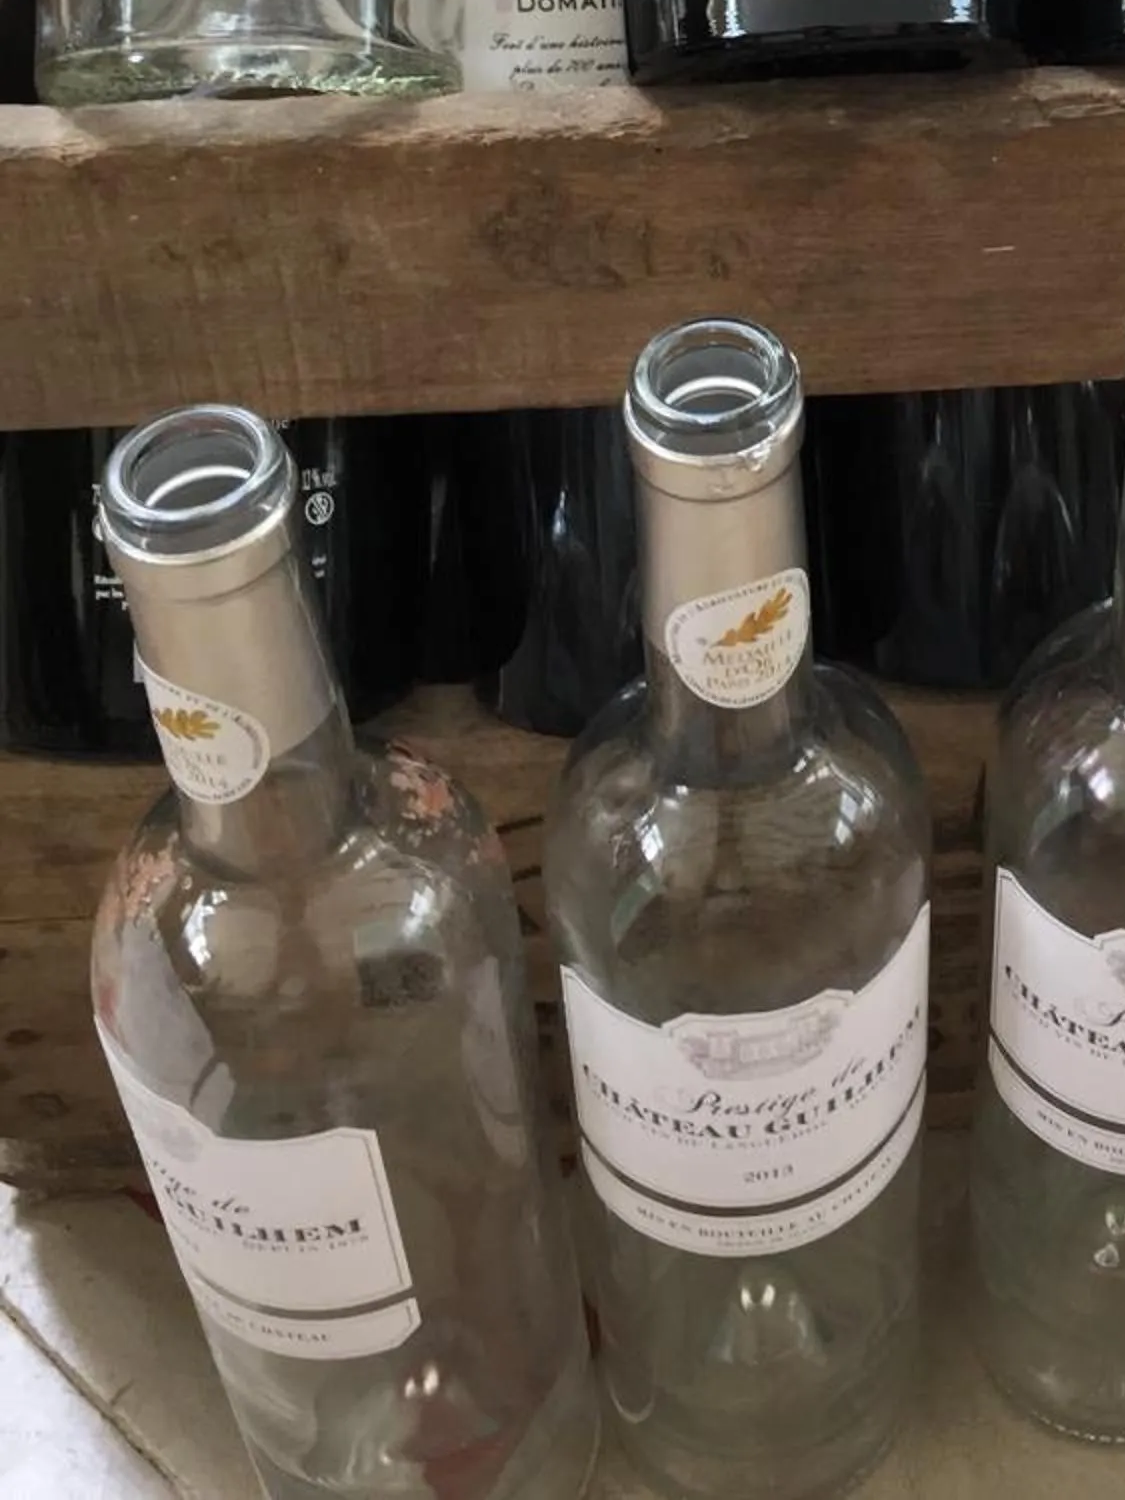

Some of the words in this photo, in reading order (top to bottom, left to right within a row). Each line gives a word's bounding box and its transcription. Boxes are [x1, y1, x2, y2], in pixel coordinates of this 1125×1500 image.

[582, 1063, 752, 1139] CHÂTEAU
[686, 1086, 817, 1120] Prestige
[743, 1163, 794, 1184] 2013
